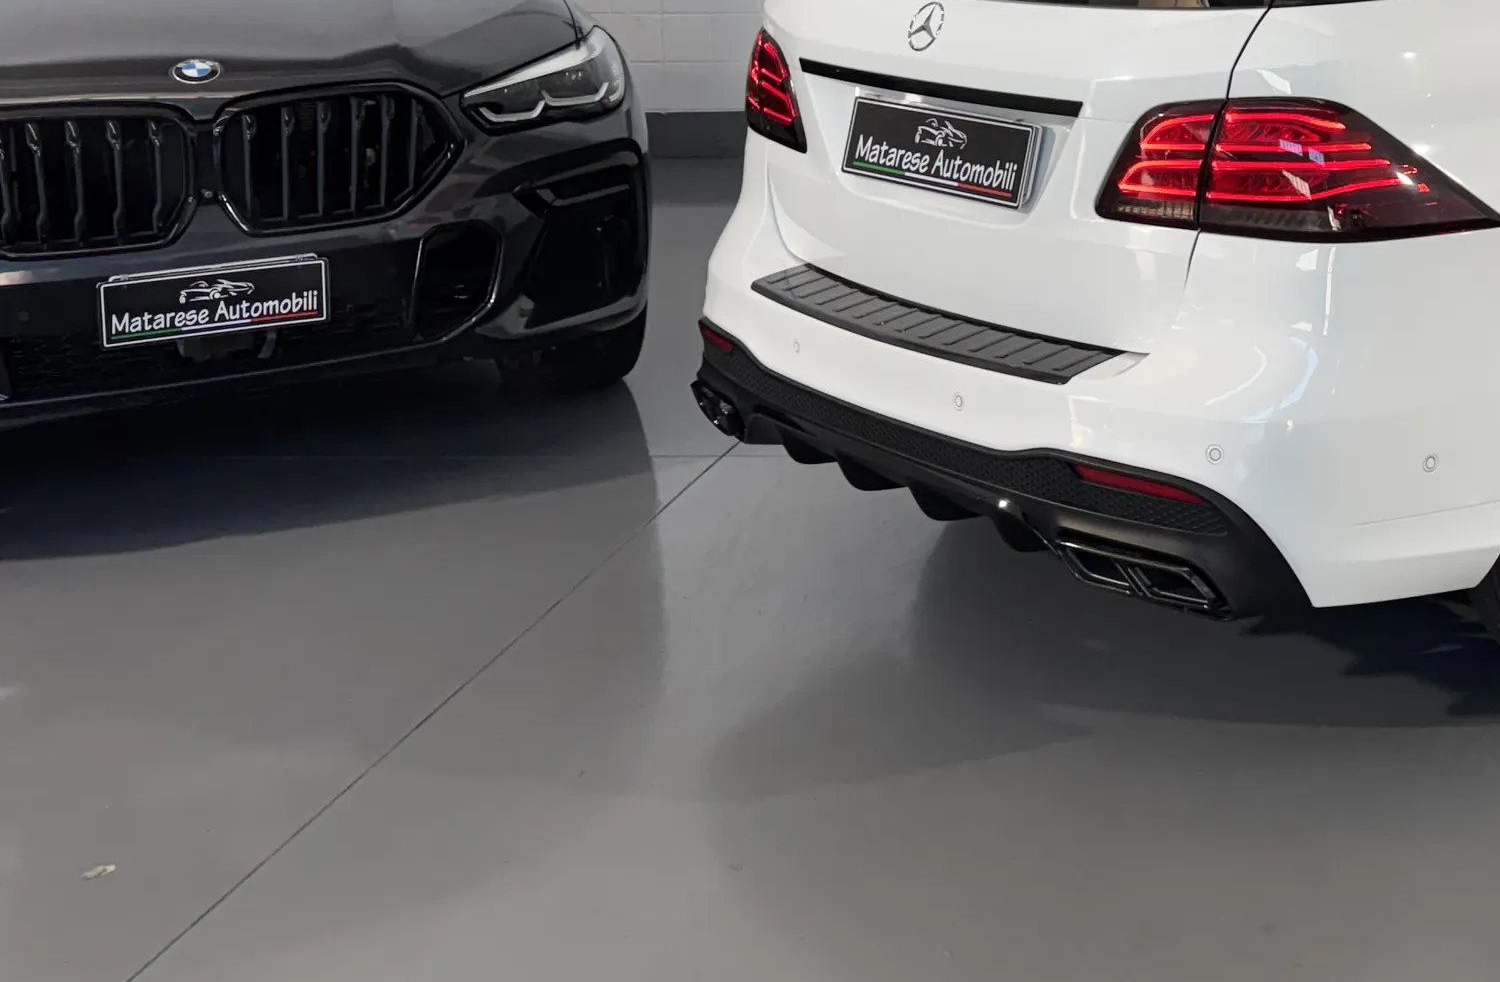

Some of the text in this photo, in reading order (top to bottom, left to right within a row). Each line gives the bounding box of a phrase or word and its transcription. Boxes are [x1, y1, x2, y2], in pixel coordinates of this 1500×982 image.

[855, 134, 1018, 191] Matarese Automobili
[111, 291, 318, 335] Matarese Automobili
